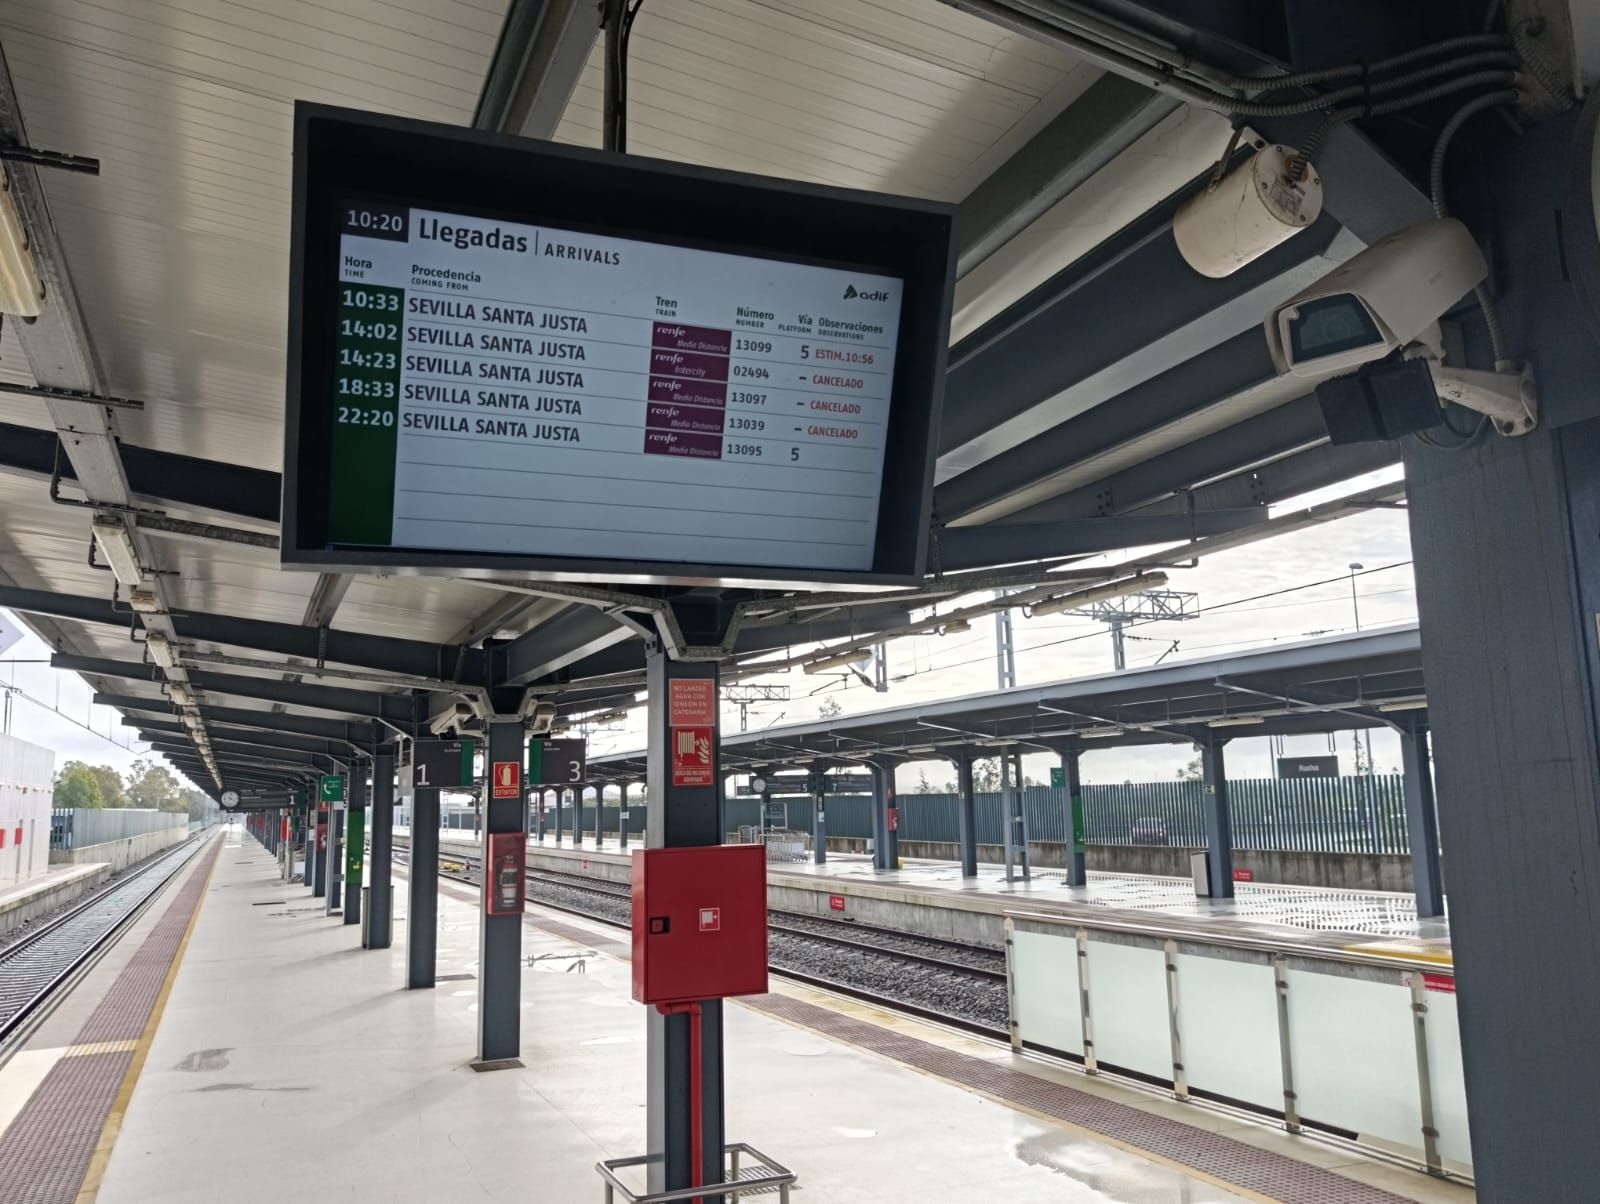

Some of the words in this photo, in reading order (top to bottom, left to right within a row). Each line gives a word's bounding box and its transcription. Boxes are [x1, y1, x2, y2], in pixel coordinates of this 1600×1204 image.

[348, 210, 402, 232] 10:20
[419, 218, 528, 253] Llegadas
[544, 242, 620, 266] ARRIVALS
[345, 255, 372, 269] Hora
[344, 269, 365, 278] TIME
[412, 264, 481, 283] Procedencia
[411, 277, 443, 288] COMING
[446, 281, 469, 291] FROM
[342, 290, 400, 311] 10:33
[656, 296, 677, 308] Tren
[859, 290, 889, 302] adif
[408, 298, 476, 320] SEVILLA
[482, 306, 534, 327] SANTA
[540, 313, 588, 334] JUSTA
[656, 308, 677, 318] TRAIN
[737, 306, 775, 320] Número
[799, 313, 813, 325] Vía
[341, 319, 398, 341] 14:02
[735, 319, 765, 329] NUMBER
[778, 323, 812, 334] PLATFORM
[818, 316, 884, 334] Observaciones
[657, 327, 686, 338] renfe
[817, 328, 864, 341] OBSERVATIONS
[408, 326, 474, 349] SEVILLA
[480, 334, 532, 355] SANTA
[538, 342, 586, 361] JUSTA
[677, 340, 697, 348] Media
[735, 339, 772, 353] 13099
[340, 349, 396, 369] 14:23
[655, 353, 684, 364] renfe
[800, 345, 810, 360] 5
[815, 349, 874, 365] ESTIM.10:56
[406, 355, 472, 378] SEVILLA
[479, 363, 531, 383] SANTA
[536, 369, 584, 388] JUSTA
[674, 365, 706, 378] Intercity
[733, 365, 769, 380] 02494
[338, 378, 394, 398] 18:33
[653, 380, 682, 391] renfe
[812, 374, 864, 390] CANCELADO
[404, 384, 470, 406] SEVILLA
[477, 391, 529, 411] SANTA
[535, 397, 582, 416] JUSTA
[672, 393, 693, 402] Media
[730, 392, 767, 405] 13097
[651, 407, 680, 418] renfe
[810, 400, 861, 415] CANCELADO
[338, 407, 394, 427] 22:20
[670, 419, 690, 428] Media
[402, 412, 469, 433] SEVILLA
[476, 419, 527, 438] SANTA
[533, 424, 580, 442] JUSTA
[728, 418, 765, 431] 13039
[648, 433, 678, 444] renfe
[807, 425, 858, 440] CANCELADO
[668, 446, 689, 454] Media
[726, 443, 763, 457] 13095
[790, 447, 800, 462] 5
[416, 763, 430, 786] 1
[568, 760, 582, 783] 3
[802, 784, 808, 792] 5
